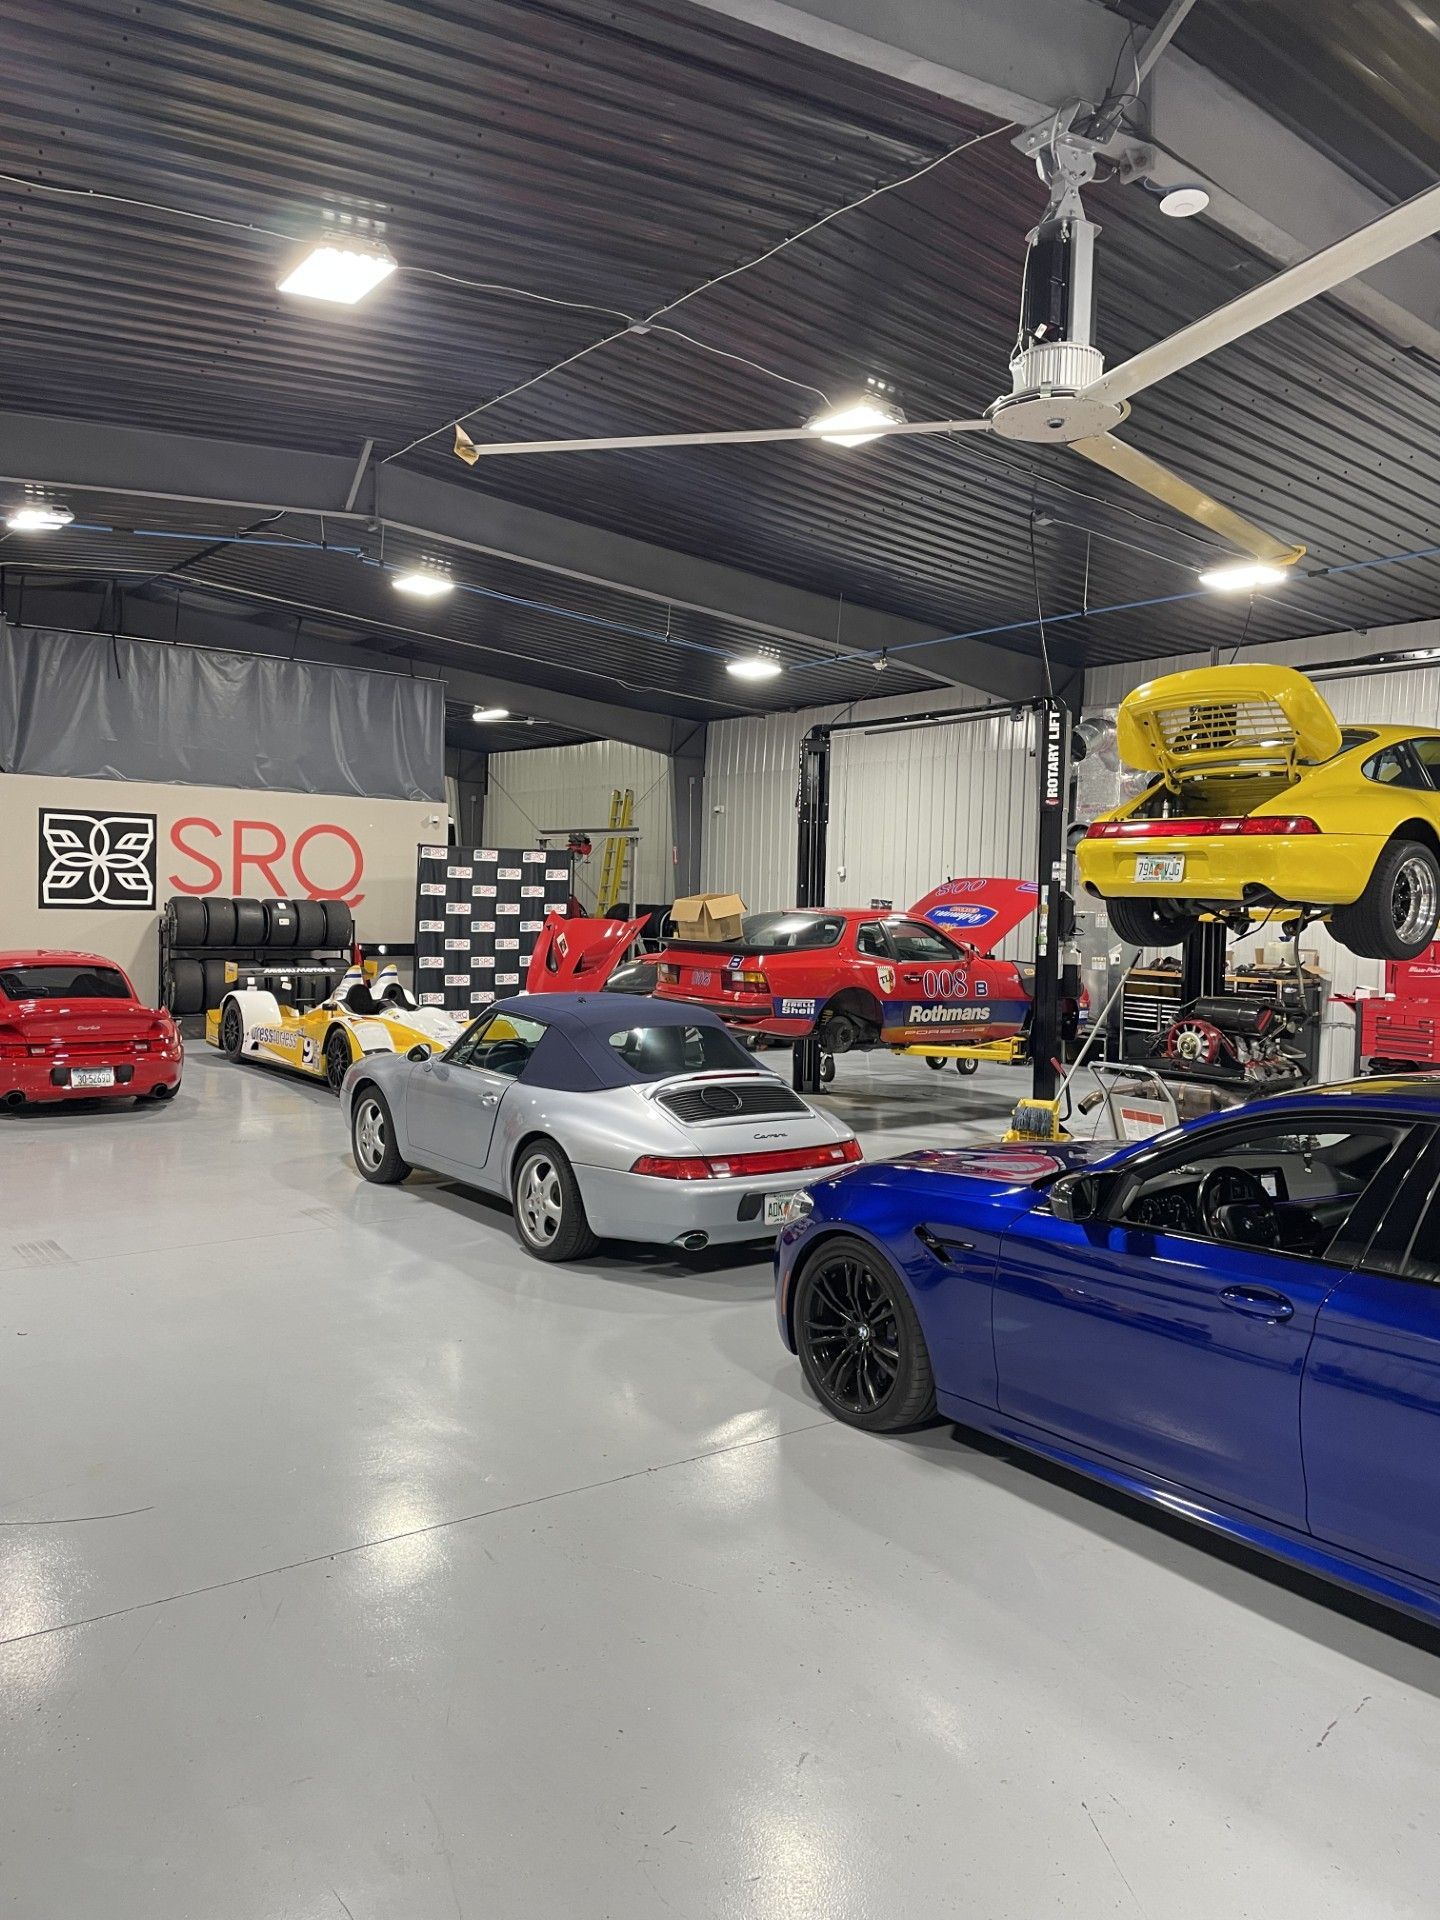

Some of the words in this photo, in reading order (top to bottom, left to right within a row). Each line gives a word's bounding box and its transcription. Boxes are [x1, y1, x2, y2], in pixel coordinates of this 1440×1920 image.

[1049, 710, 1060, 740] LIFT
[1047, 743, 1059, 798] ROTARY
[168, 817, 366, 909] SRQ
[922, 969, 968, 999] 008
[974, 980, 988, 997] B
[781, 1007, 815, 1015] Shell
[909, 1005, 991, 1023] Rothmans
[905, 1028, 986, 1036] PORSCHE
[302, 1039, 315, 1063] 9
